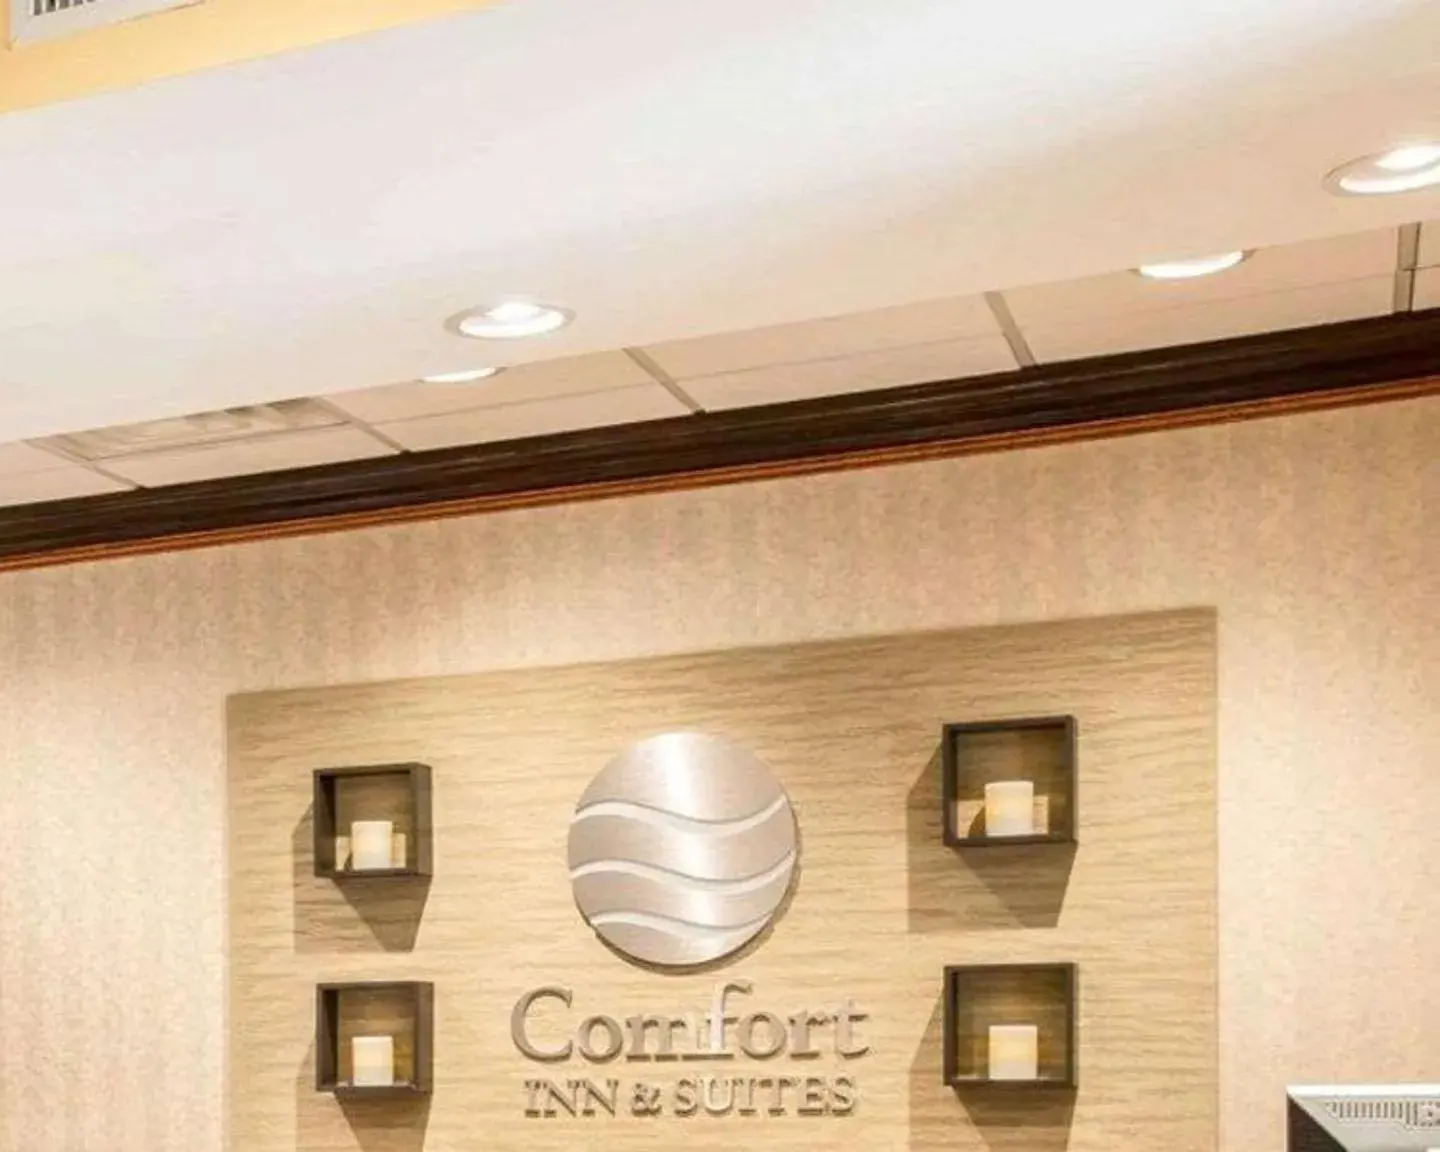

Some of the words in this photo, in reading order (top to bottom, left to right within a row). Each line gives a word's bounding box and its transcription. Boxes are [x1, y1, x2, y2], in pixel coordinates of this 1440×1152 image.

[511, 982, 869, 1063] Comfort
[524, 1079, 620, 1118] INN
[631, 1082, 663, 1118] &
[674, 1078, 856, 1118] SUITES
